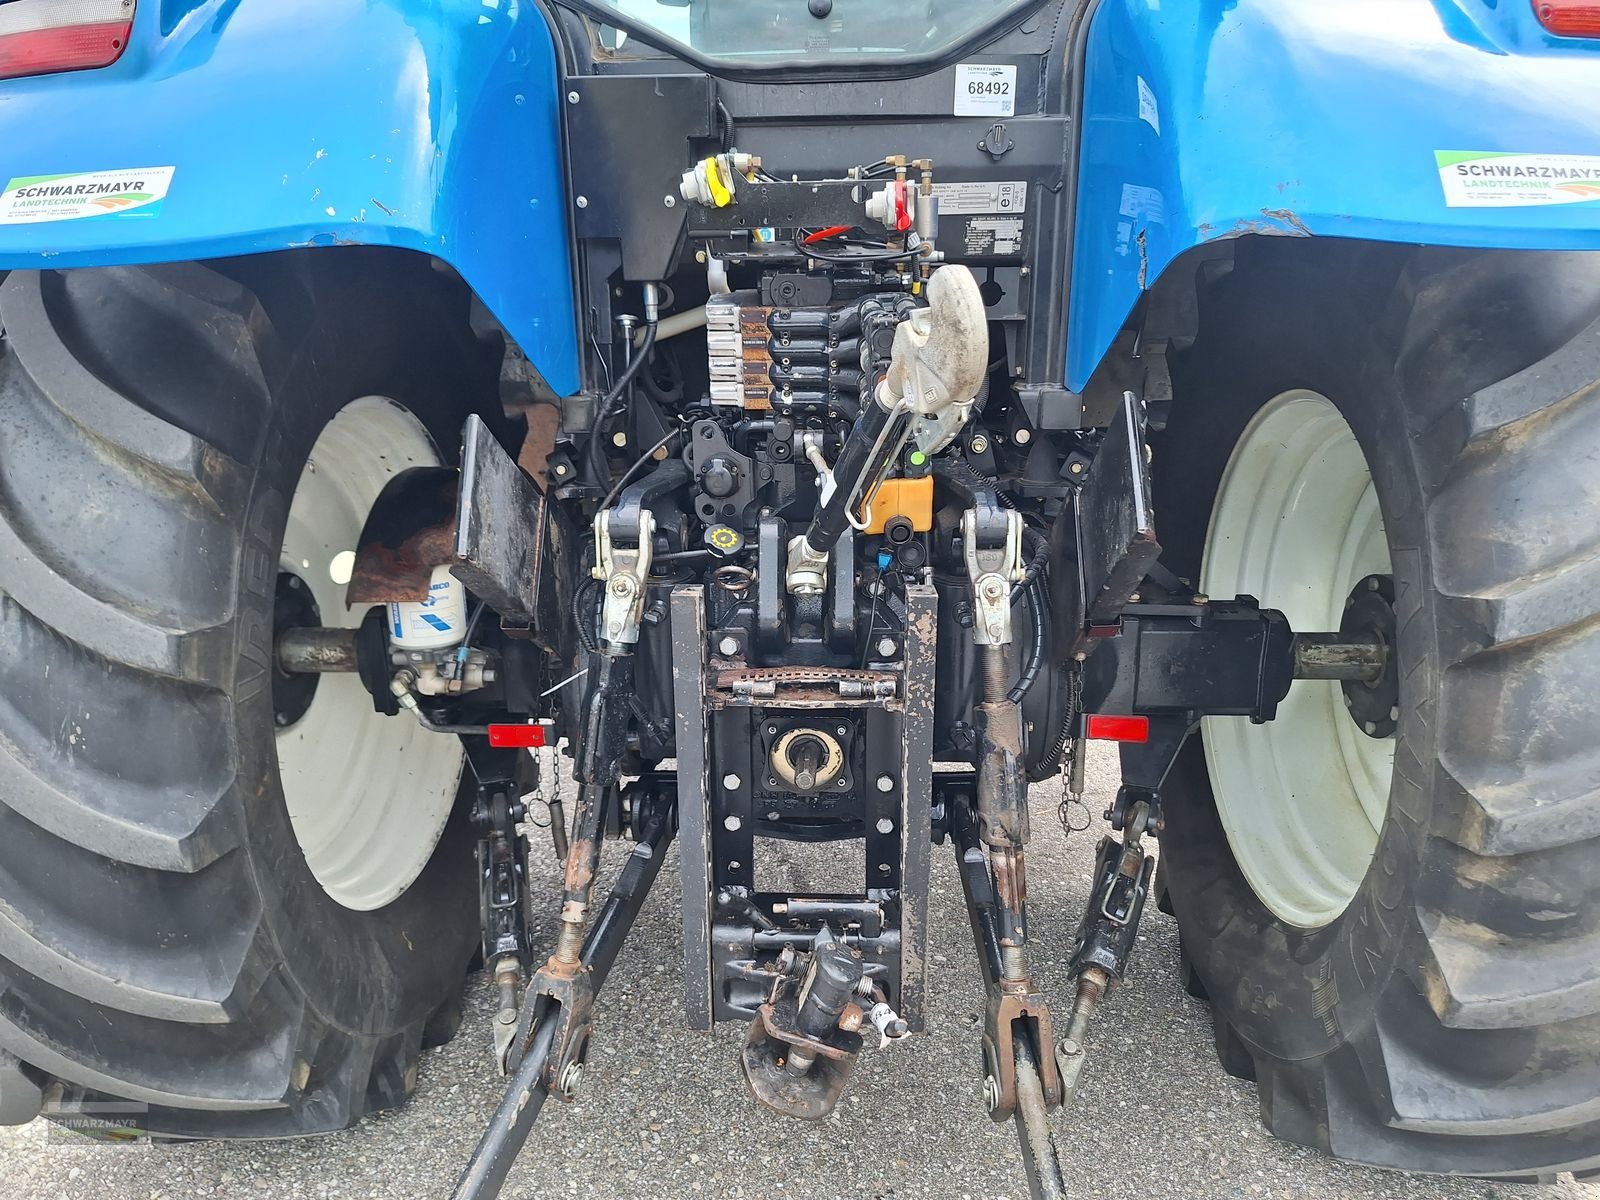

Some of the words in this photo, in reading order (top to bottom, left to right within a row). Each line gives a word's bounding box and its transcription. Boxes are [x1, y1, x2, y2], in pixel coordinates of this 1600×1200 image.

[968, 81, 1009, 95] 68492
[15, 181, 145, 199] SCHWARZMAYR
[1463, 180, 1551, 189] LANDTECHNIK
[12, 197, 88, 208] LANDTECHNIK
